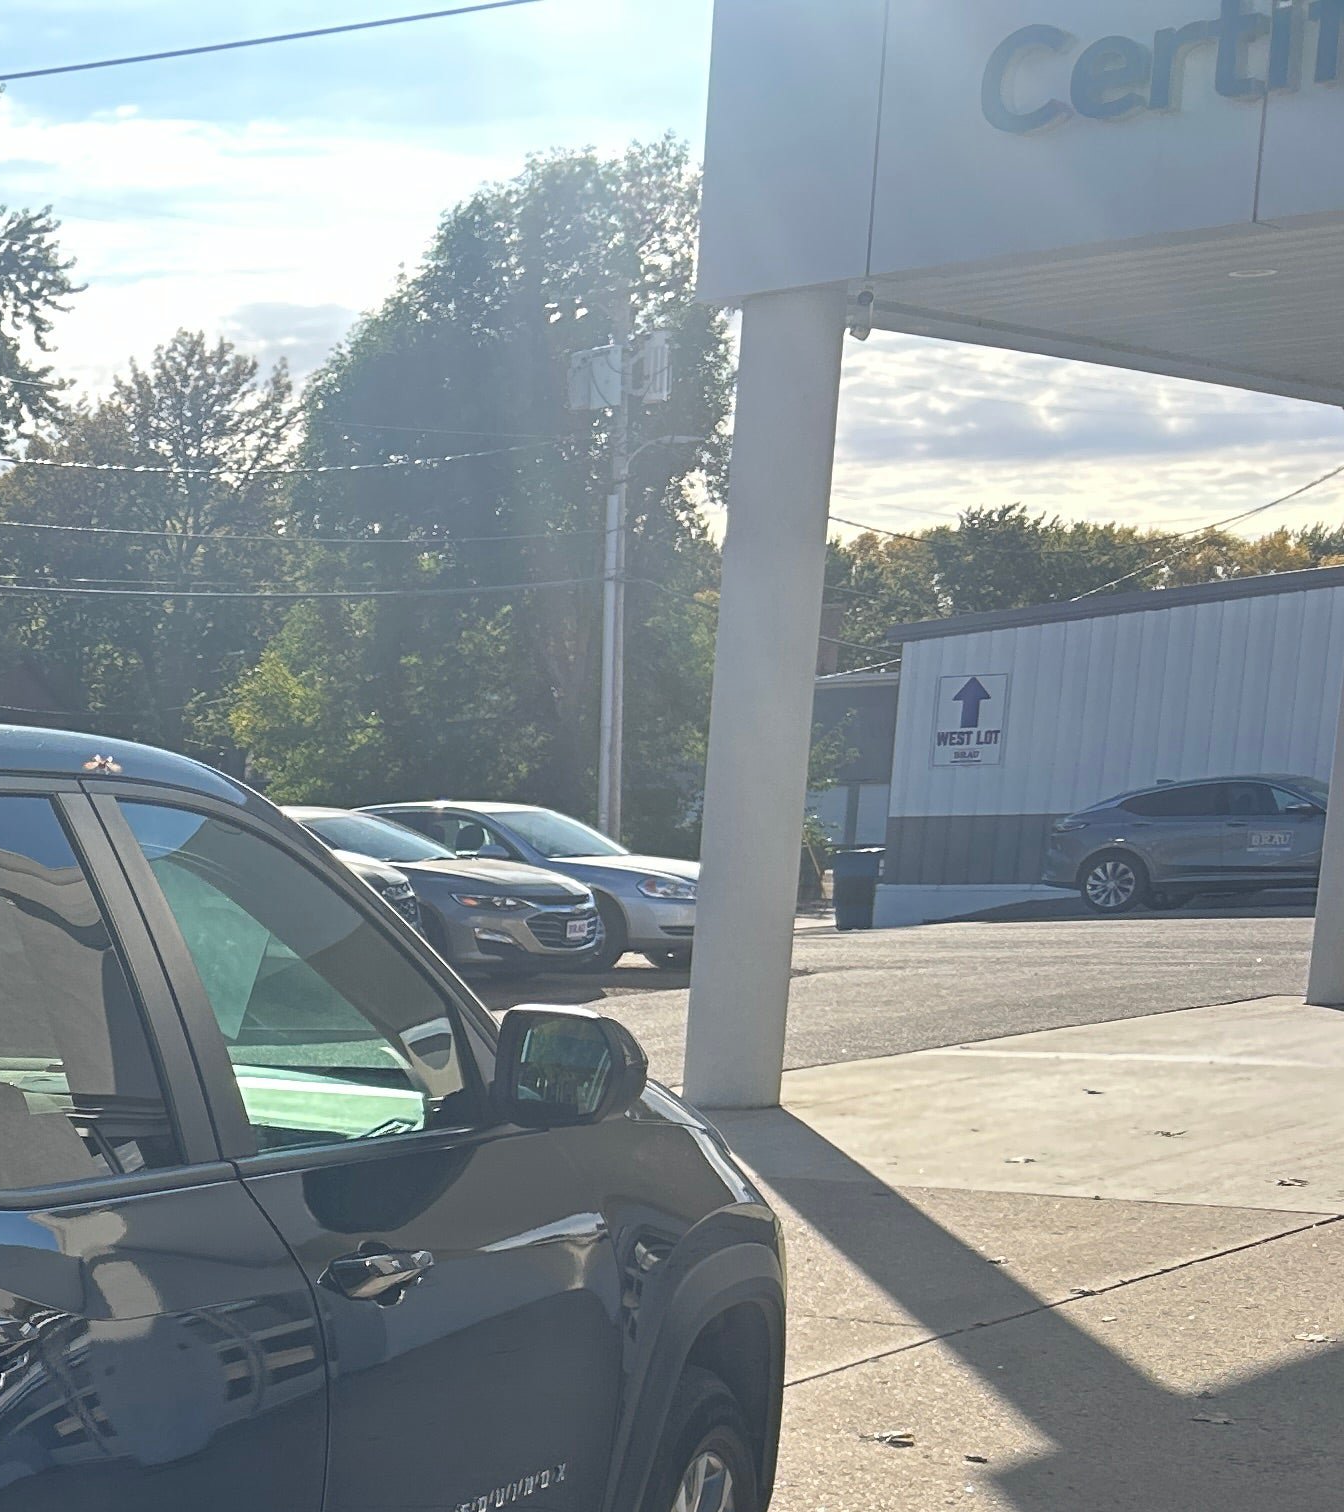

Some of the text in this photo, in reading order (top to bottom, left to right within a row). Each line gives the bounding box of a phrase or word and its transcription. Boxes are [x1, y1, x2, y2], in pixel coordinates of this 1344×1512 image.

[937, 730, 1000, 746] WEST LOT
[1252, 833, 1290, 846] BRAU
